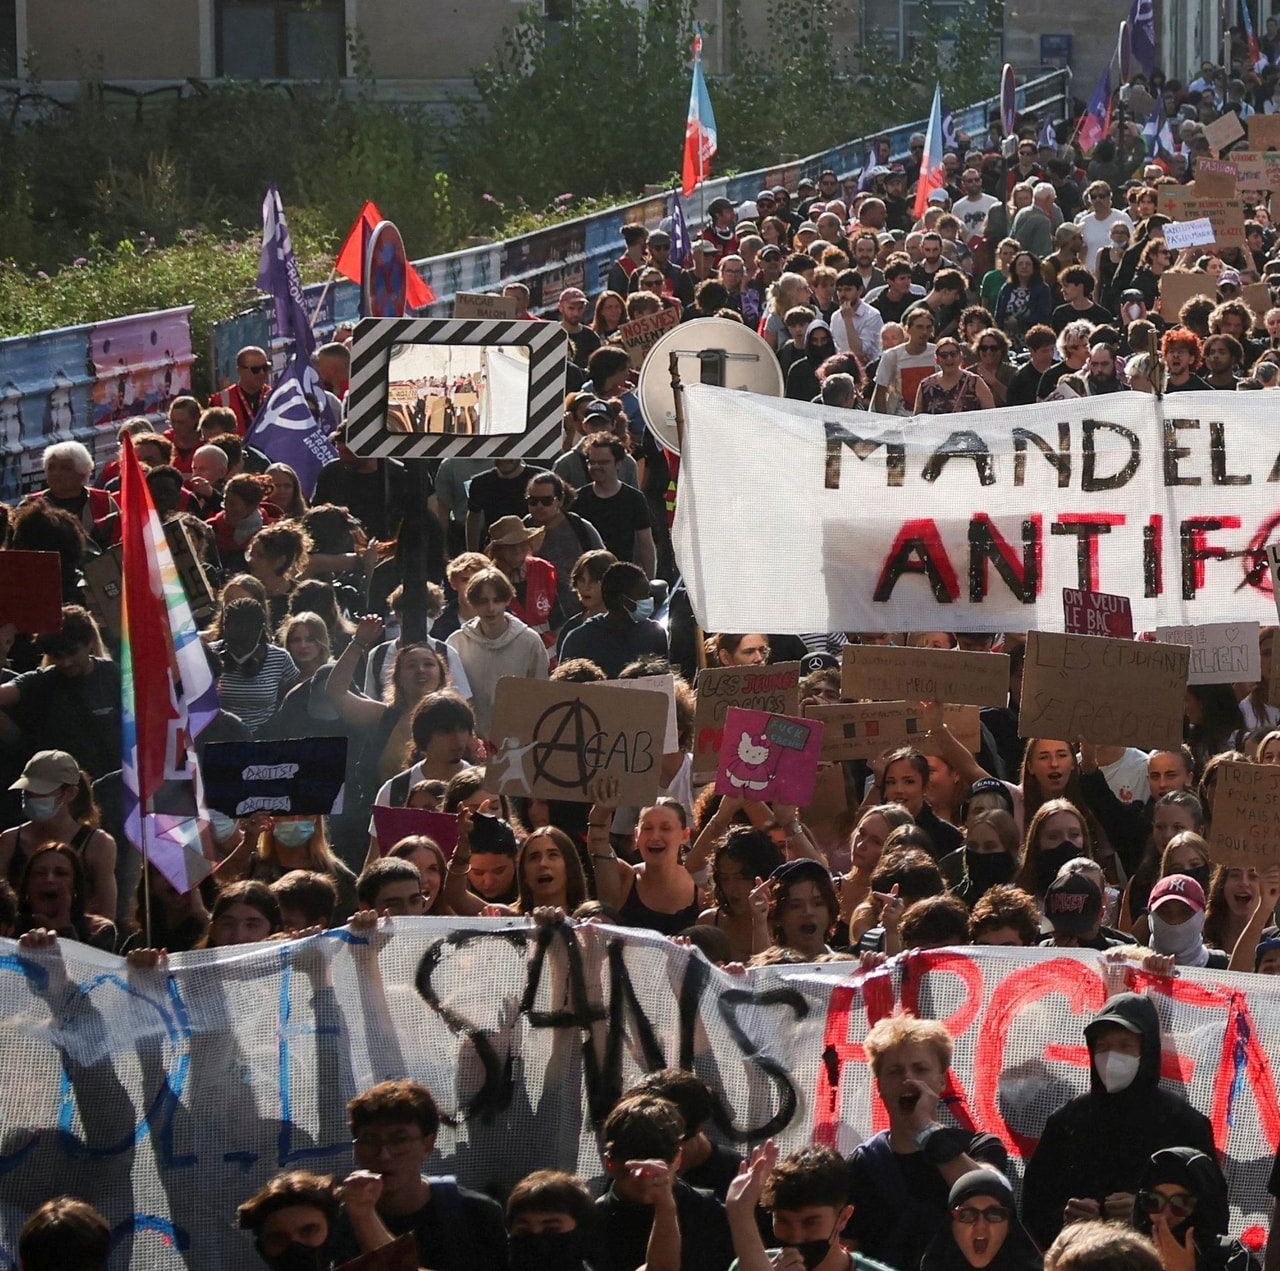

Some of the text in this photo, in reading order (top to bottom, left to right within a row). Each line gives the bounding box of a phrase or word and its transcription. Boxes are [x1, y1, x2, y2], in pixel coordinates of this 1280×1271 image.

[1199, 161, 1236, 175] FASHION
[622, 310, 675, 339] NOS VIES
[316, 427, 330, 442] LA
[1064, 590, 1129, 613] ON VEUT
[1066, 607, 1111, 632] LE BAC
[1165, 627, 1207, 644] FREE
[1036, 633, 1092, 670] LES
[702, 671, 799, 697] LES JEUNES
[245, 764, 294, 779] DROITS!
[1223, 766, 1262, 785] TROP
[241, 796, 290, 812] DROITES!
[1266, 793, 1280, 805] SE
[1237, 807, 1269, 823] MAIS
[1218, 833, 1249, 850] POUR
[415, 921, 808, 1142] SANS
